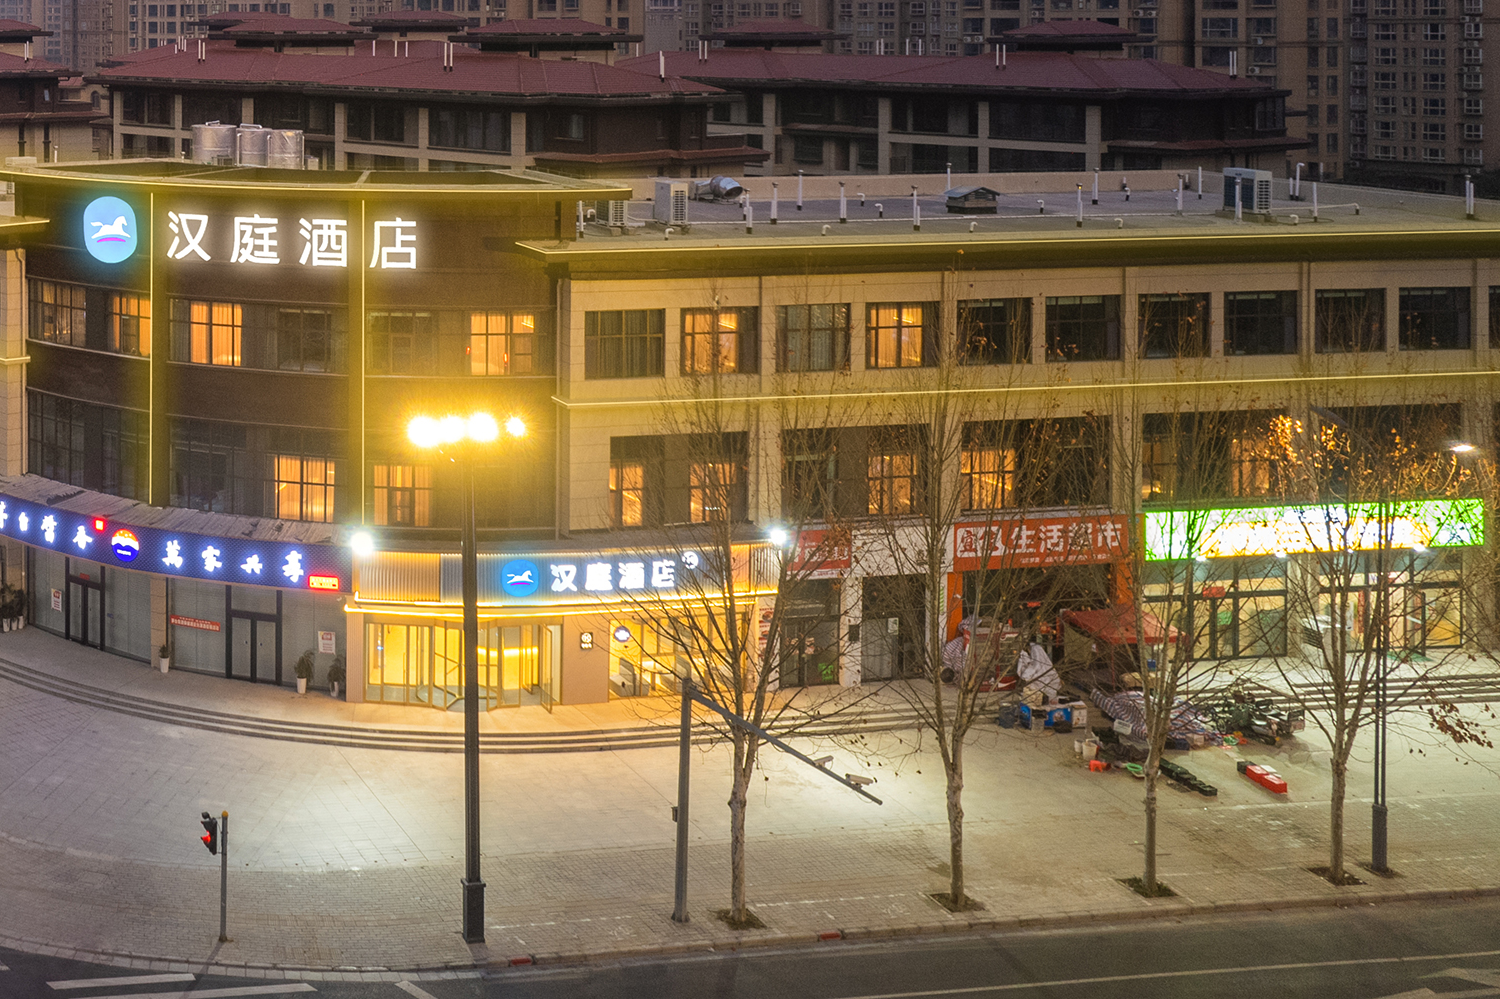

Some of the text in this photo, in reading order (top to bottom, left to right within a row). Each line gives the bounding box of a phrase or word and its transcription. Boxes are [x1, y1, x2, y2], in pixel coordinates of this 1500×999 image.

[167, 210, 417, 270] 汉庭酒店
[549, 559, 676, 592] 汉庭酒店
